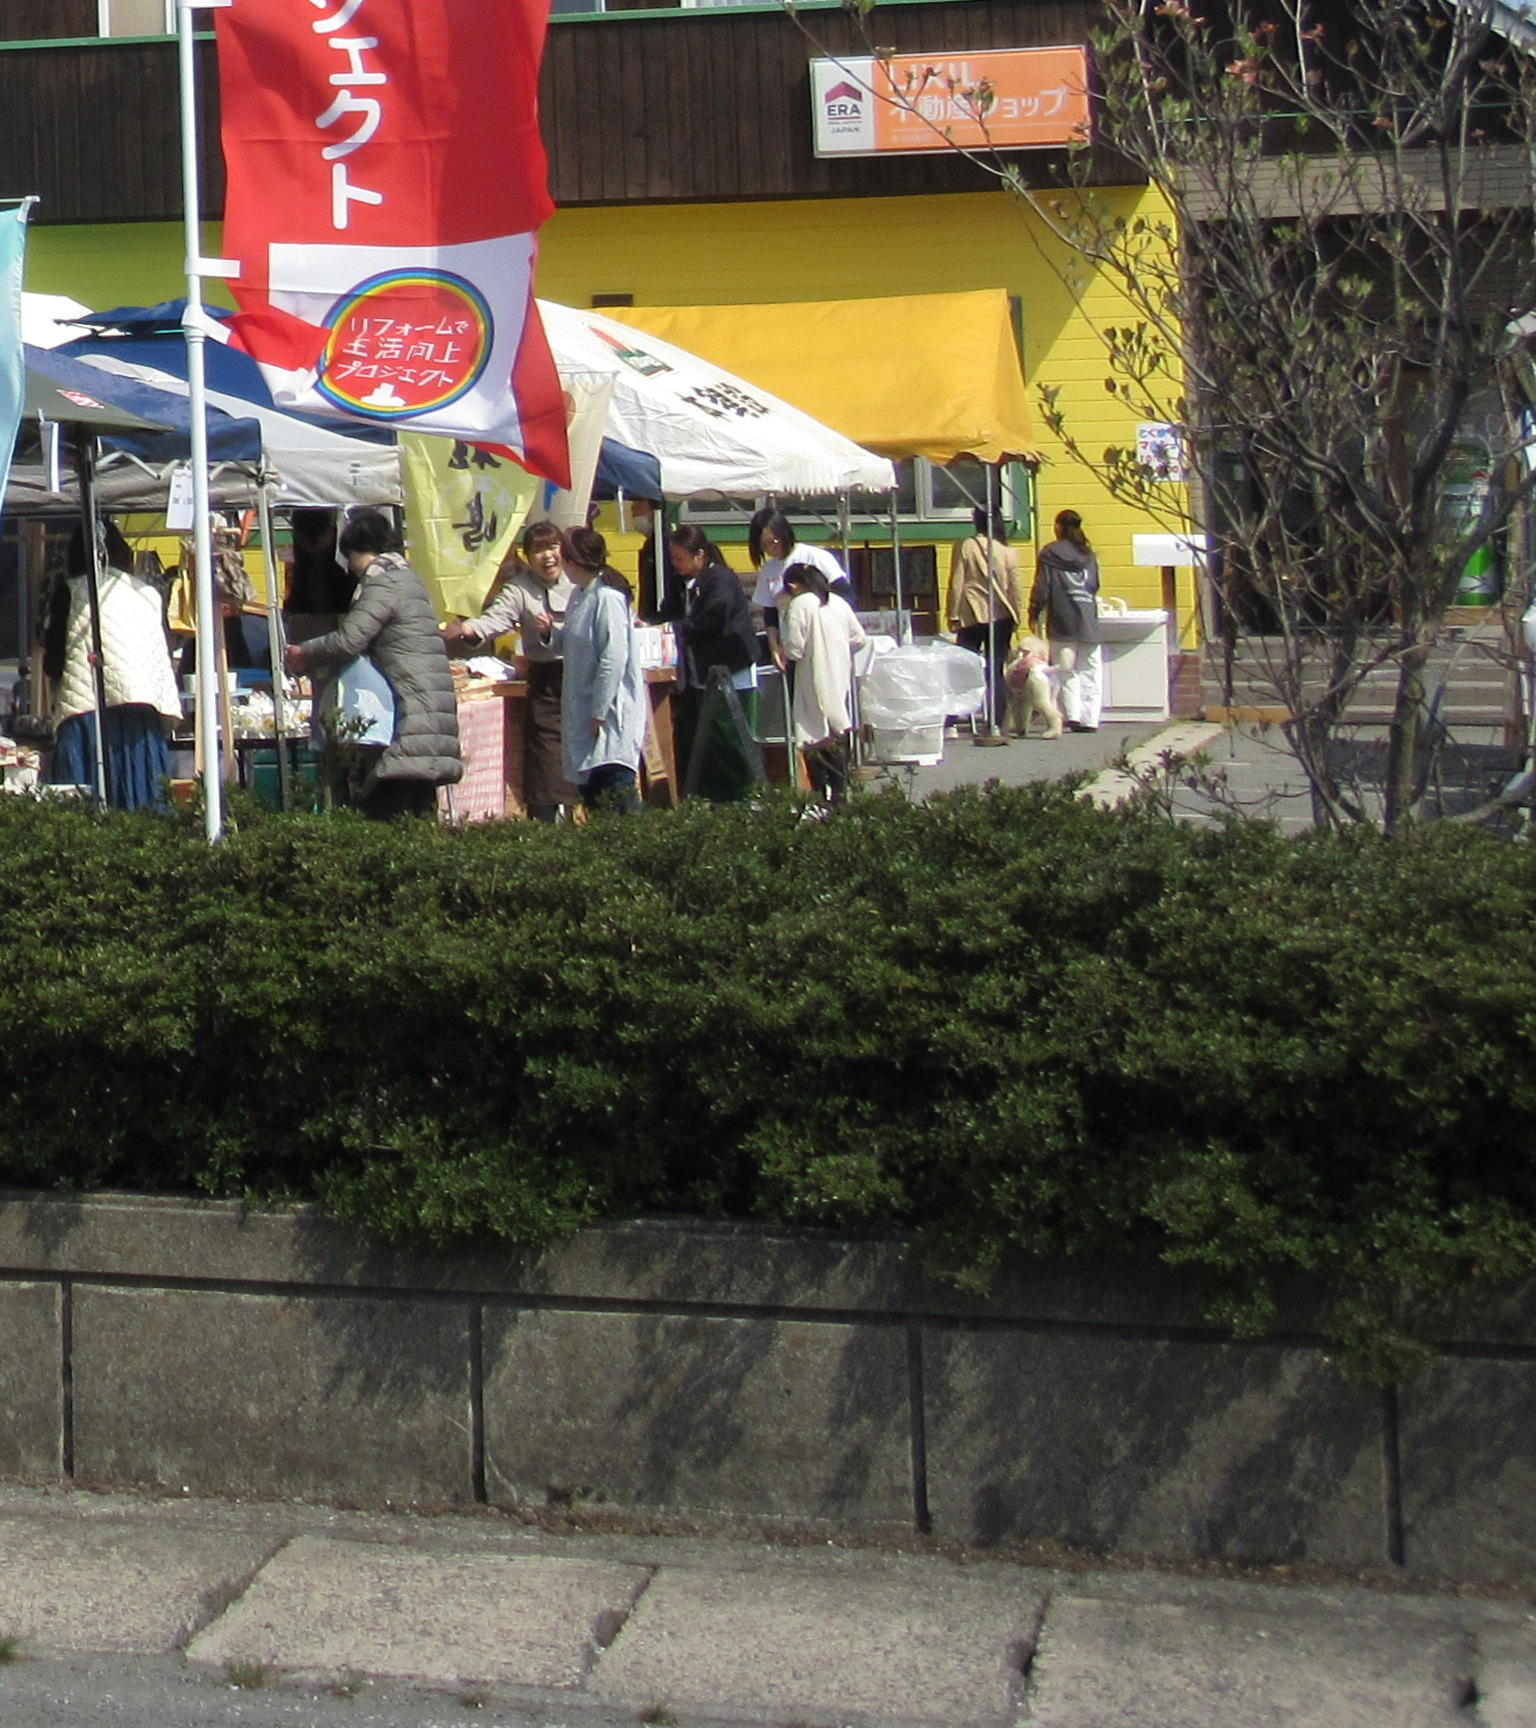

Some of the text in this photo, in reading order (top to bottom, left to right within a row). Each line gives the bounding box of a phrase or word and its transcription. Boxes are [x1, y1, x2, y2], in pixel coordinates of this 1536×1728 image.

[827, 103, 862, 116] ERA
[350, 316, 469, 339] リフォームで
[342, 337, 462, 364] 生活向上
[334, 359, 455, 388] プロジェクト
